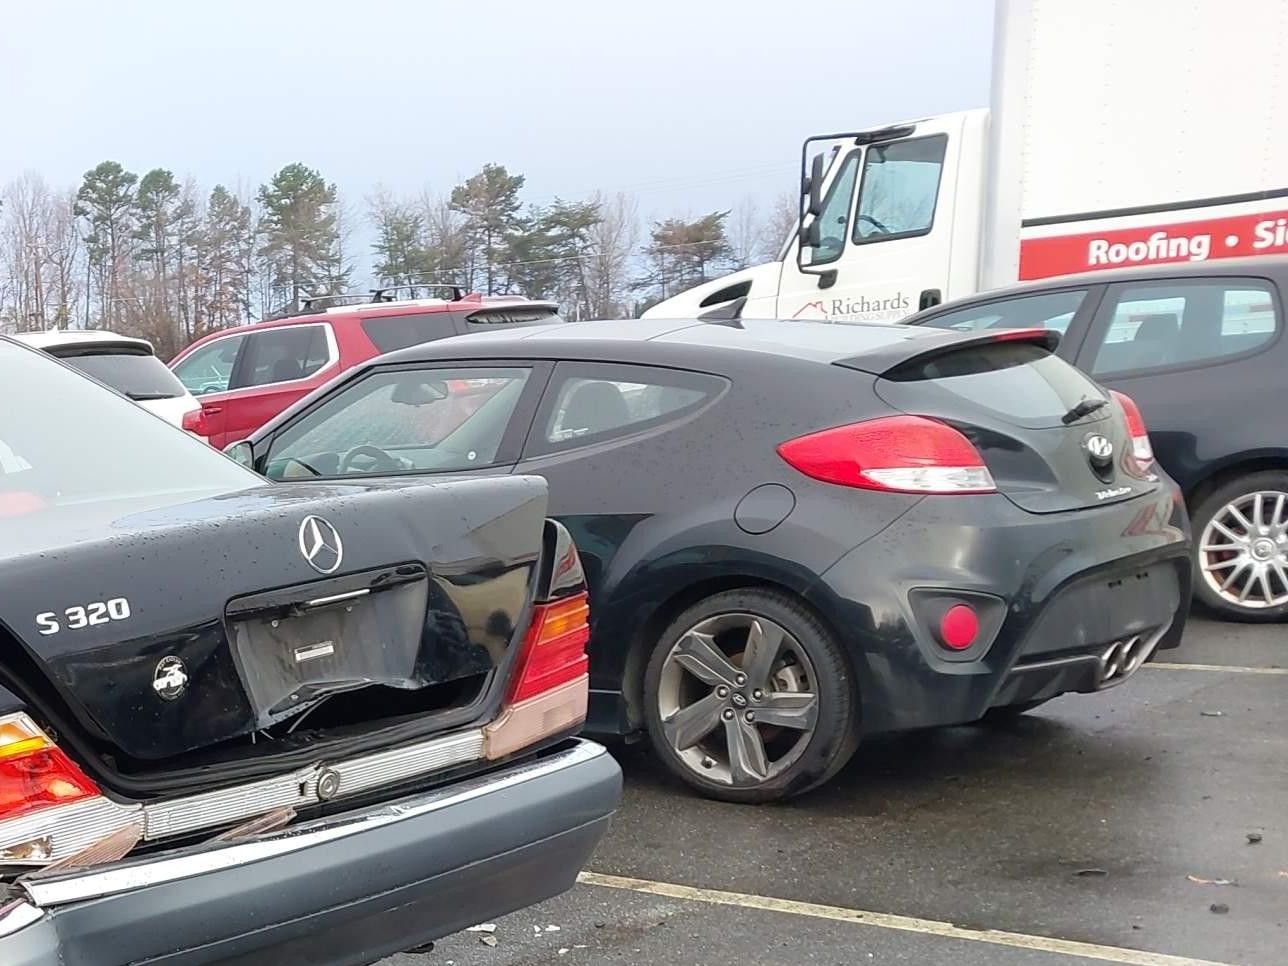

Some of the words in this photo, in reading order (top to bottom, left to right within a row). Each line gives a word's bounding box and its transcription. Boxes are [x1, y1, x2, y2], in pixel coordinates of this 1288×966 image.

[1088, 231, 1212, 265] Roofing
[832, 292, 910, 316] Richards
[36, 611, 60, 635] S
[64, 597, 131, 629] 320
